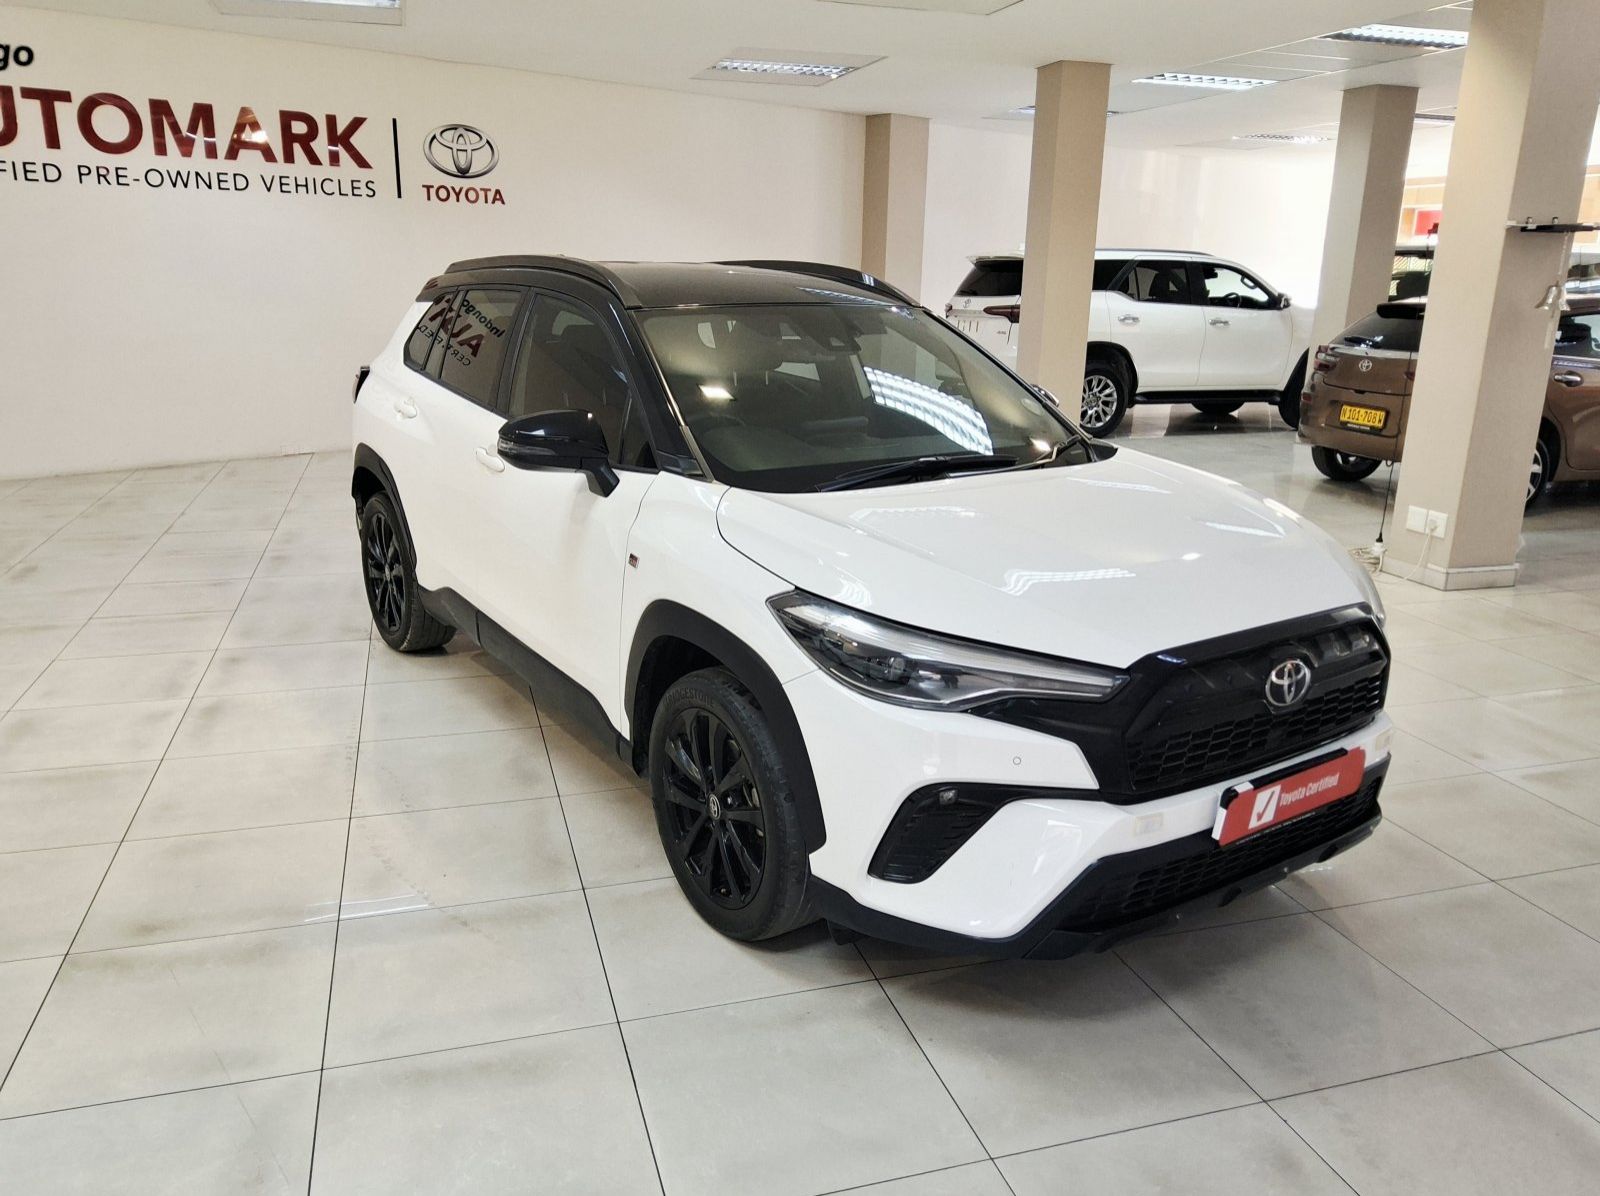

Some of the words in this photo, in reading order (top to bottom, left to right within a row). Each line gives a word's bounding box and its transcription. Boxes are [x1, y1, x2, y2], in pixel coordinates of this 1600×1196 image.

[77, 164, 249, 191] PRE-OWNED
[260, 174, 376, 198] VEHICLES
[422, 184, 505, 205] TOYOTA
[1280, 787, 1306, 807] Toyota
[1306, 772, 1339, 796] Certified
